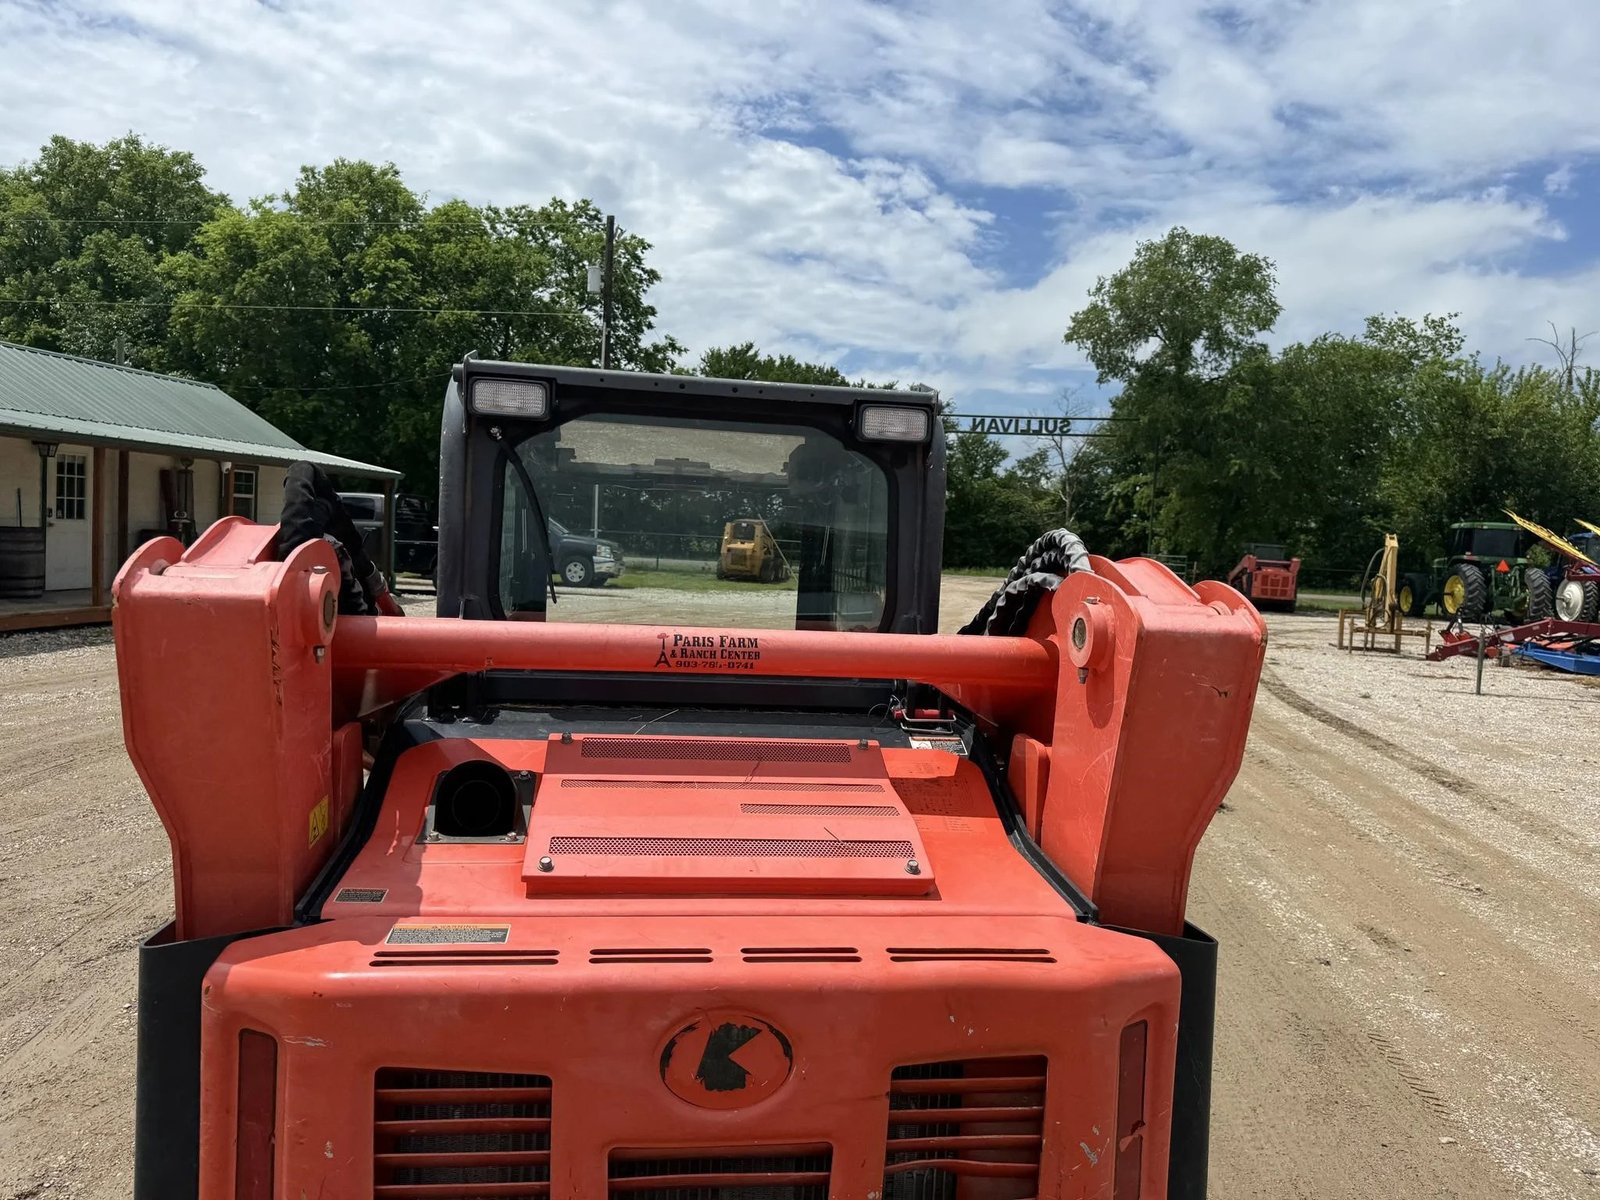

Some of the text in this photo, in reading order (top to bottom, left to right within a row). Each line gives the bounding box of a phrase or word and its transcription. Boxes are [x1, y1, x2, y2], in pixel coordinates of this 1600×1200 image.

[673, 634, 759, 649] PARIS FARM
[670, 648, 761, 660] & RANCH CENTER
